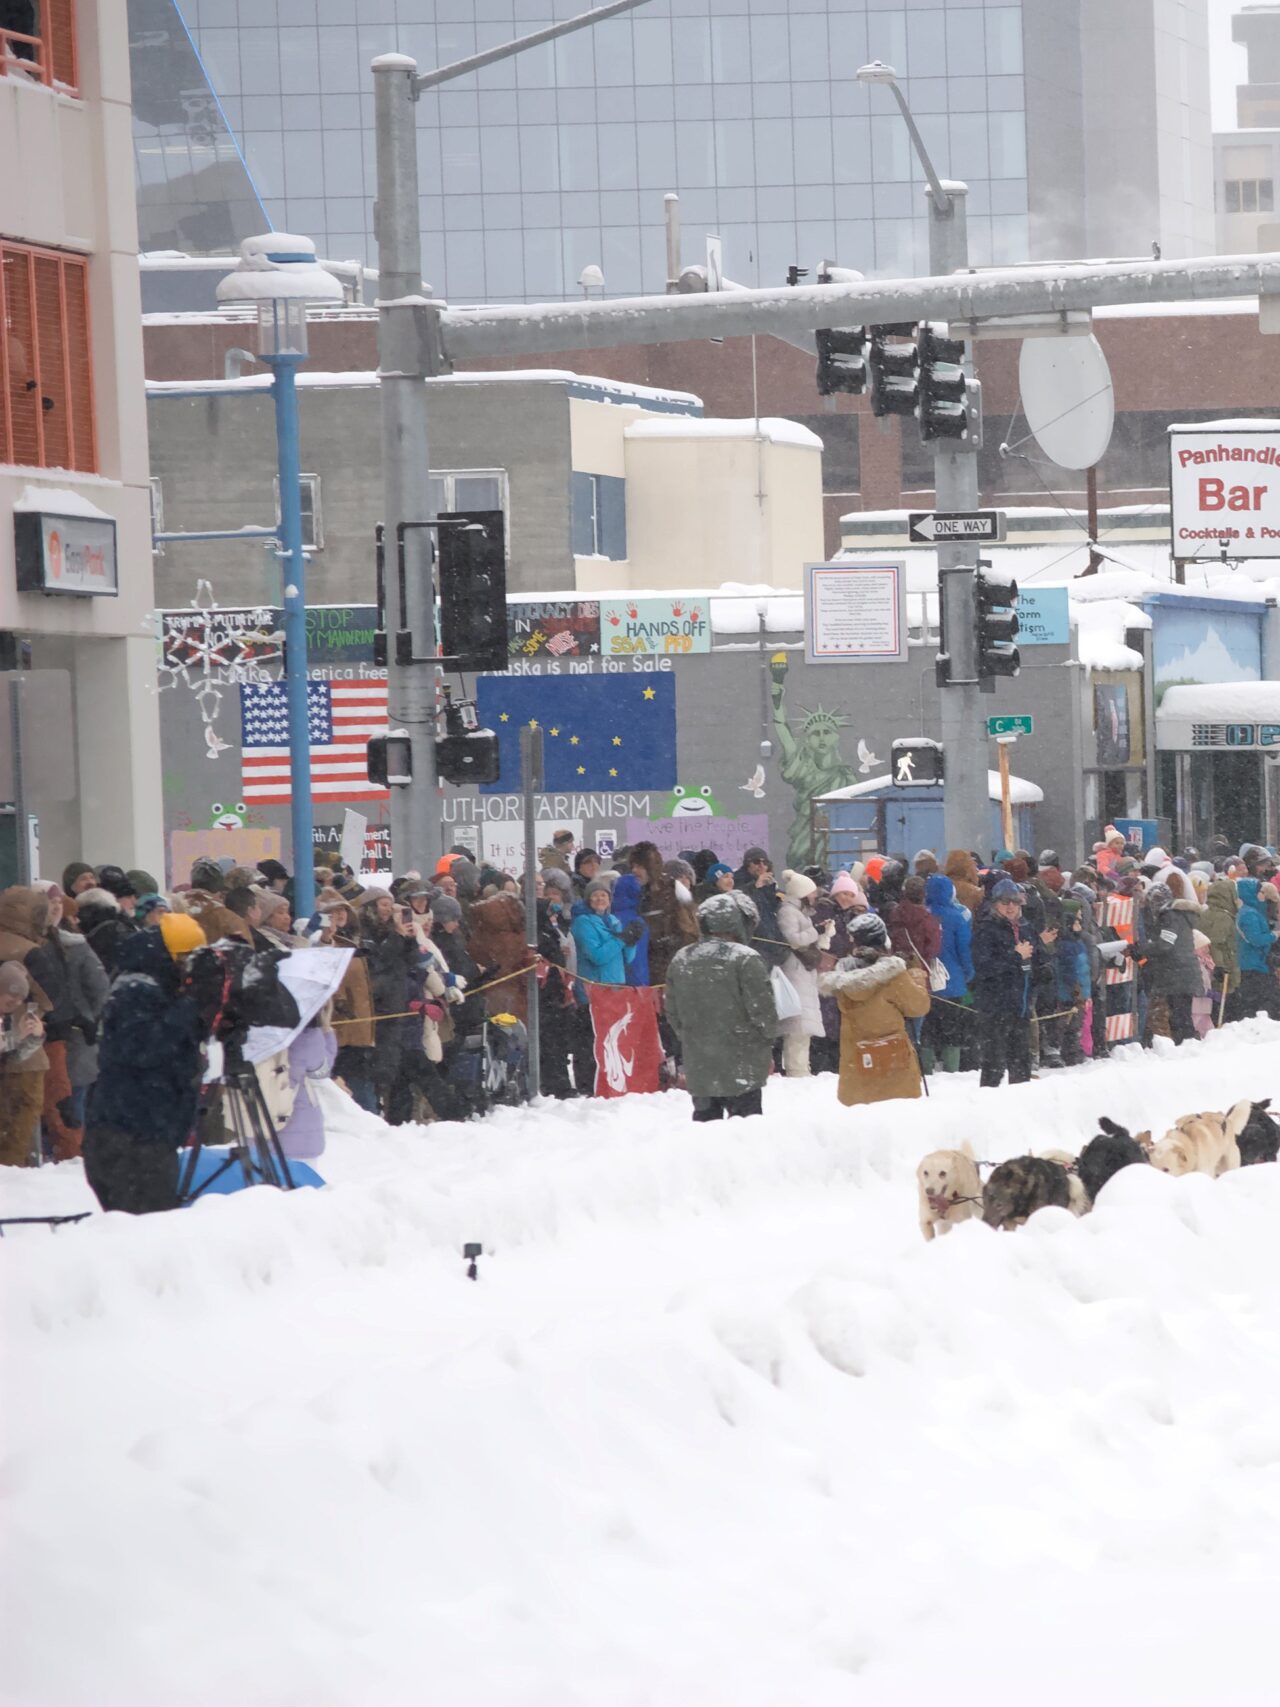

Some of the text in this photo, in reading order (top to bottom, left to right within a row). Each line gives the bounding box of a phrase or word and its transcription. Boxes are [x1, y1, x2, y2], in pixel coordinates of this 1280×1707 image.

[1199, 478, 1268, 511] Bar
[935, 521, 988, 533] ONE WAY
[1179, 527, 1240, 540] Cocktails
[1246, 527, 1256, 539] &
[305, 609, 354, 629] STOP
[515, 619, 531, 634] IN
[626, 620, 707, 639] HANDS OFF
[358, 662, 389, 681] free
[547, 659, 562, 675] is
[570, 655, 596, 675] not
[601, 656, 627, 674] for
[632, 655, 672, 673] Sale
[995, 720, 1005, 732] C
[440, 795, 651, 822] UTHORITARIANISM
